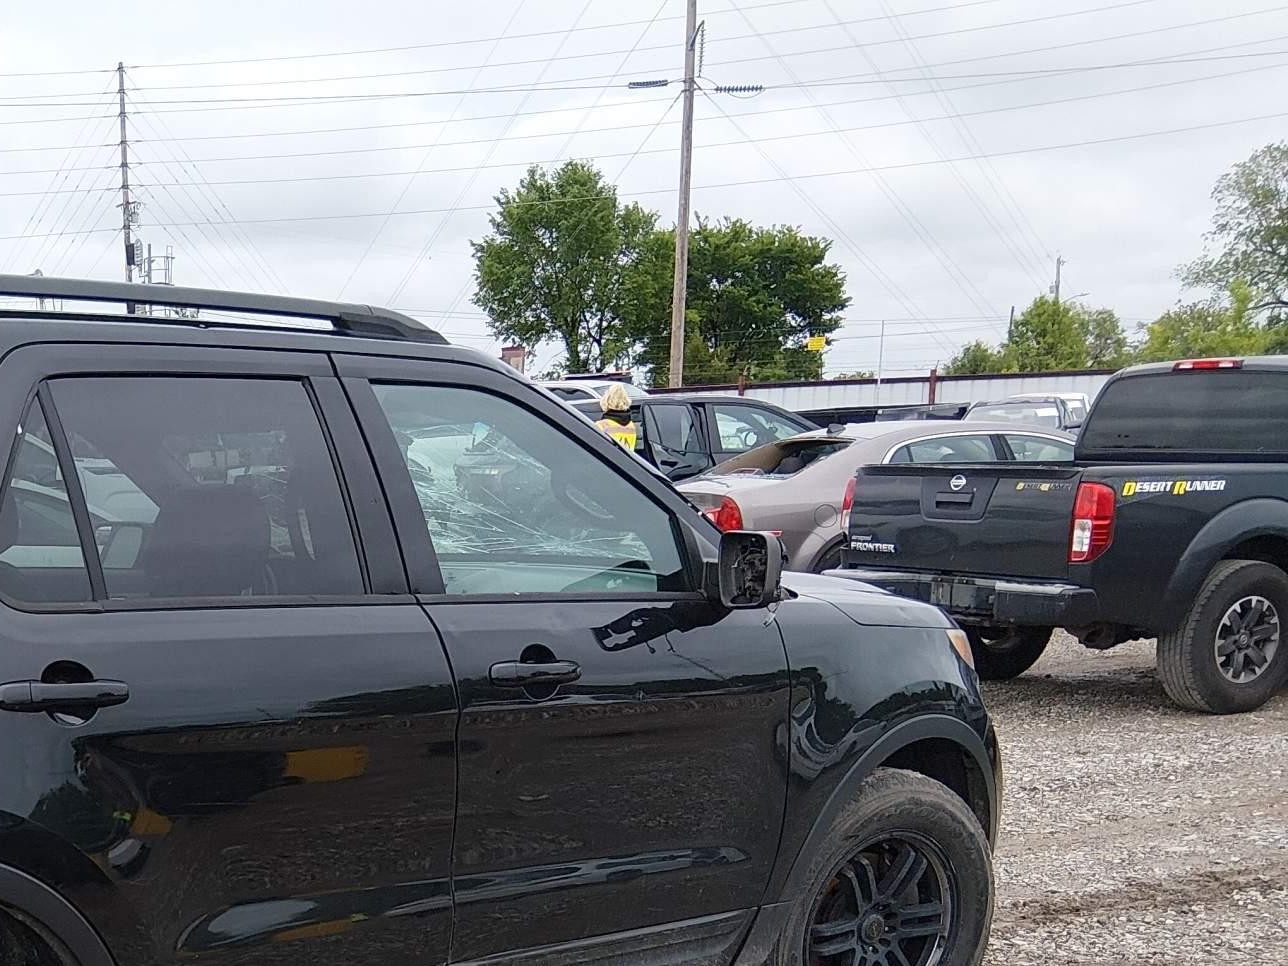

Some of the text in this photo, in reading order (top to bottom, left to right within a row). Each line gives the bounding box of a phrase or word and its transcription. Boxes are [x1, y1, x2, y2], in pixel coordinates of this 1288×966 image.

[1122, 480, 1226, 496] DESERT RUNNER
[850, 541, 895, 553] FRONTIER
